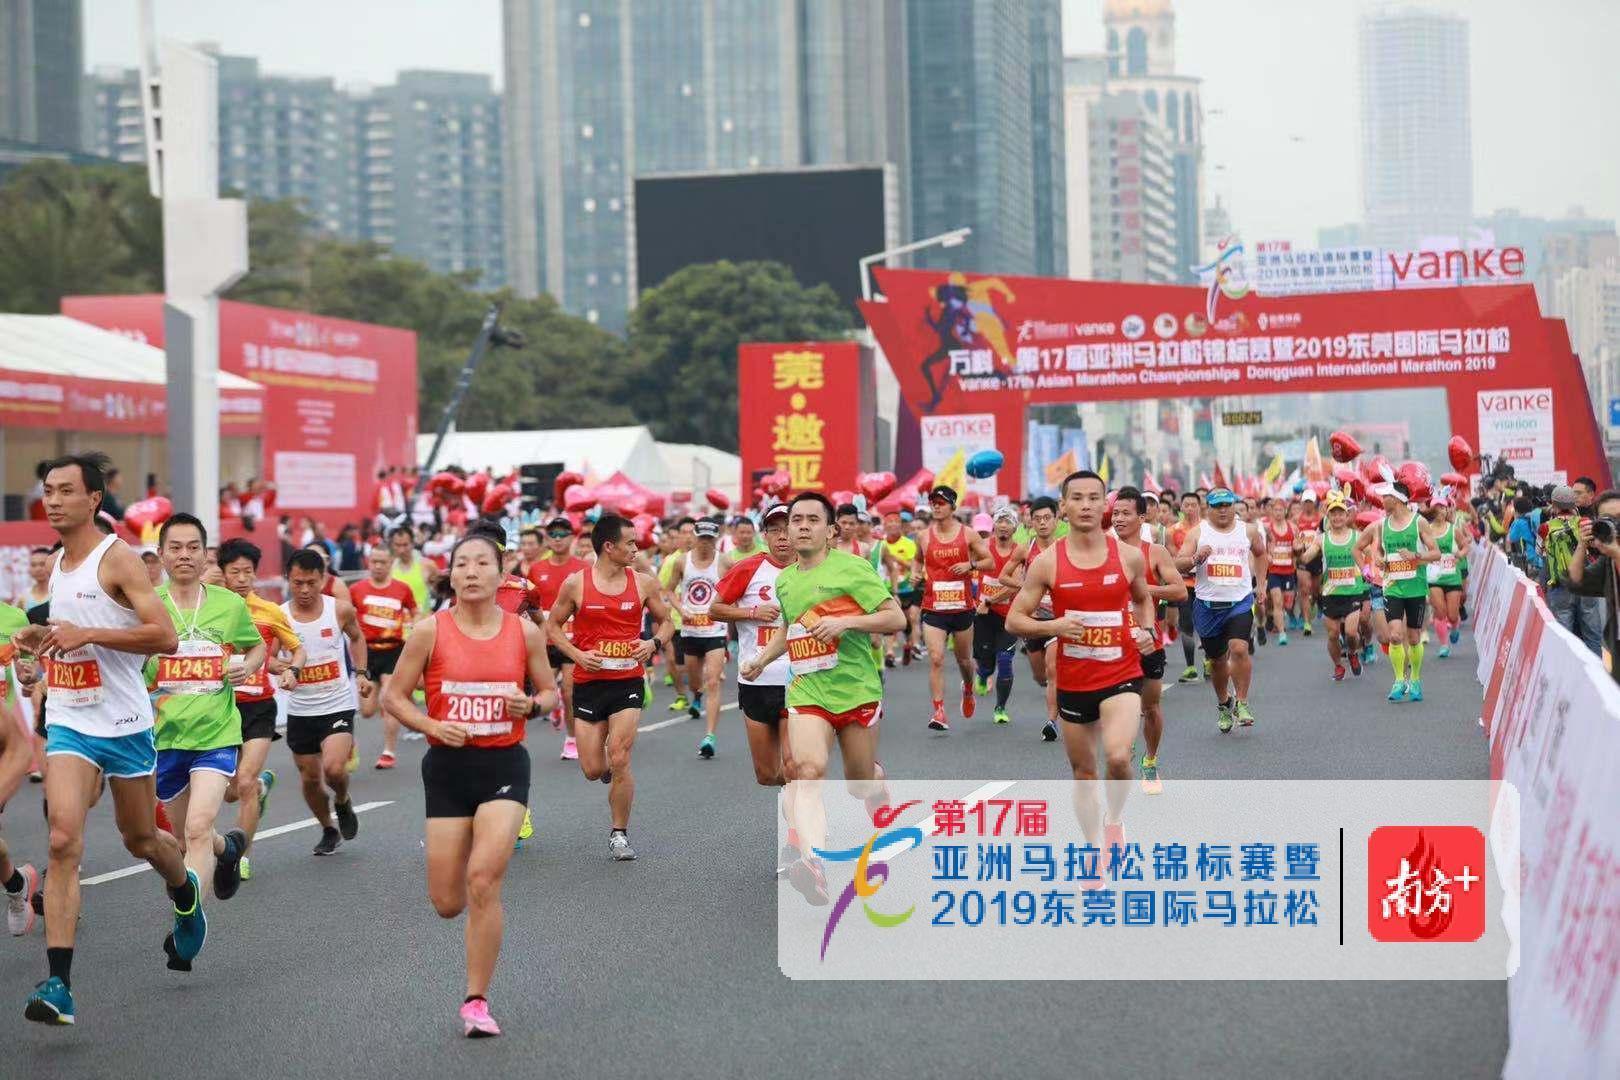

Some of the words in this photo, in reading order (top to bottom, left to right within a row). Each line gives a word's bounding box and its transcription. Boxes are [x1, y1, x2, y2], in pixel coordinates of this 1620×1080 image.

[1389, 246, 1525, 280] vanke
[1036, 373, 1073, 388] Asian
[1076, 370, 1137, 386] Marathon
[1139, 365, 1240, 385] Championships
[1247, 362, 1313, 382] Dongguan
[1317, 359, 1397, 376] International
[1401, 356, 1461, 373] Marathon
[1465, 357, 1496, 370] 2019
[1481, 394, 1550, 412] vanke
[925, 420, 992, 437] vanke
[164, 659, 213, 679] 14245
[447, 696, 504, 721] 20619
